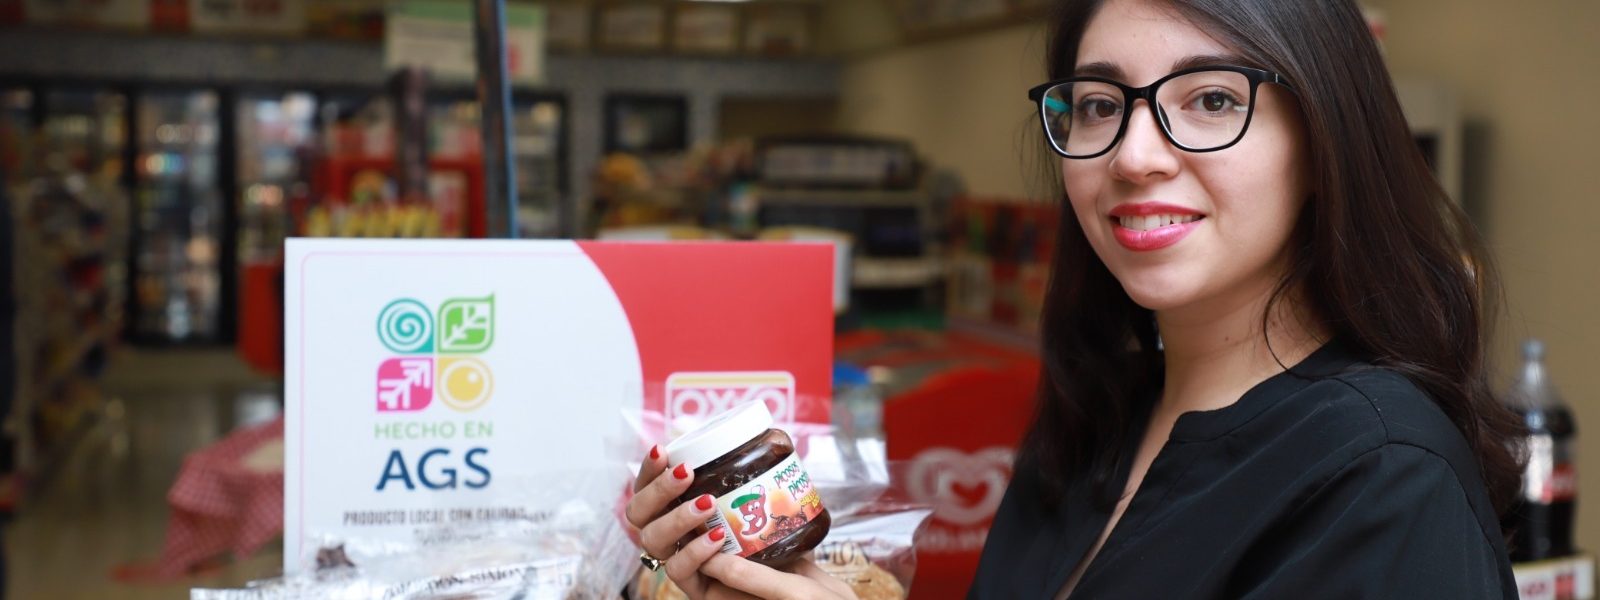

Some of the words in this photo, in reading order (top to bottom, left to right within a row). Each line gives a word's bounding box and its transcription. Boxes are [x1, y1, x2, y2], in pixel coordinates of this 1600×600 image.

[374, 421, 457, 440] HECHO
[464, 421, 494, 438] EN
[375, 447, 492, 491] AGS
[343, 510, 406, 526] PRODUCTO
[409, 508, 445, 525] LOCAL
[449, 507, 473, 522] CON
